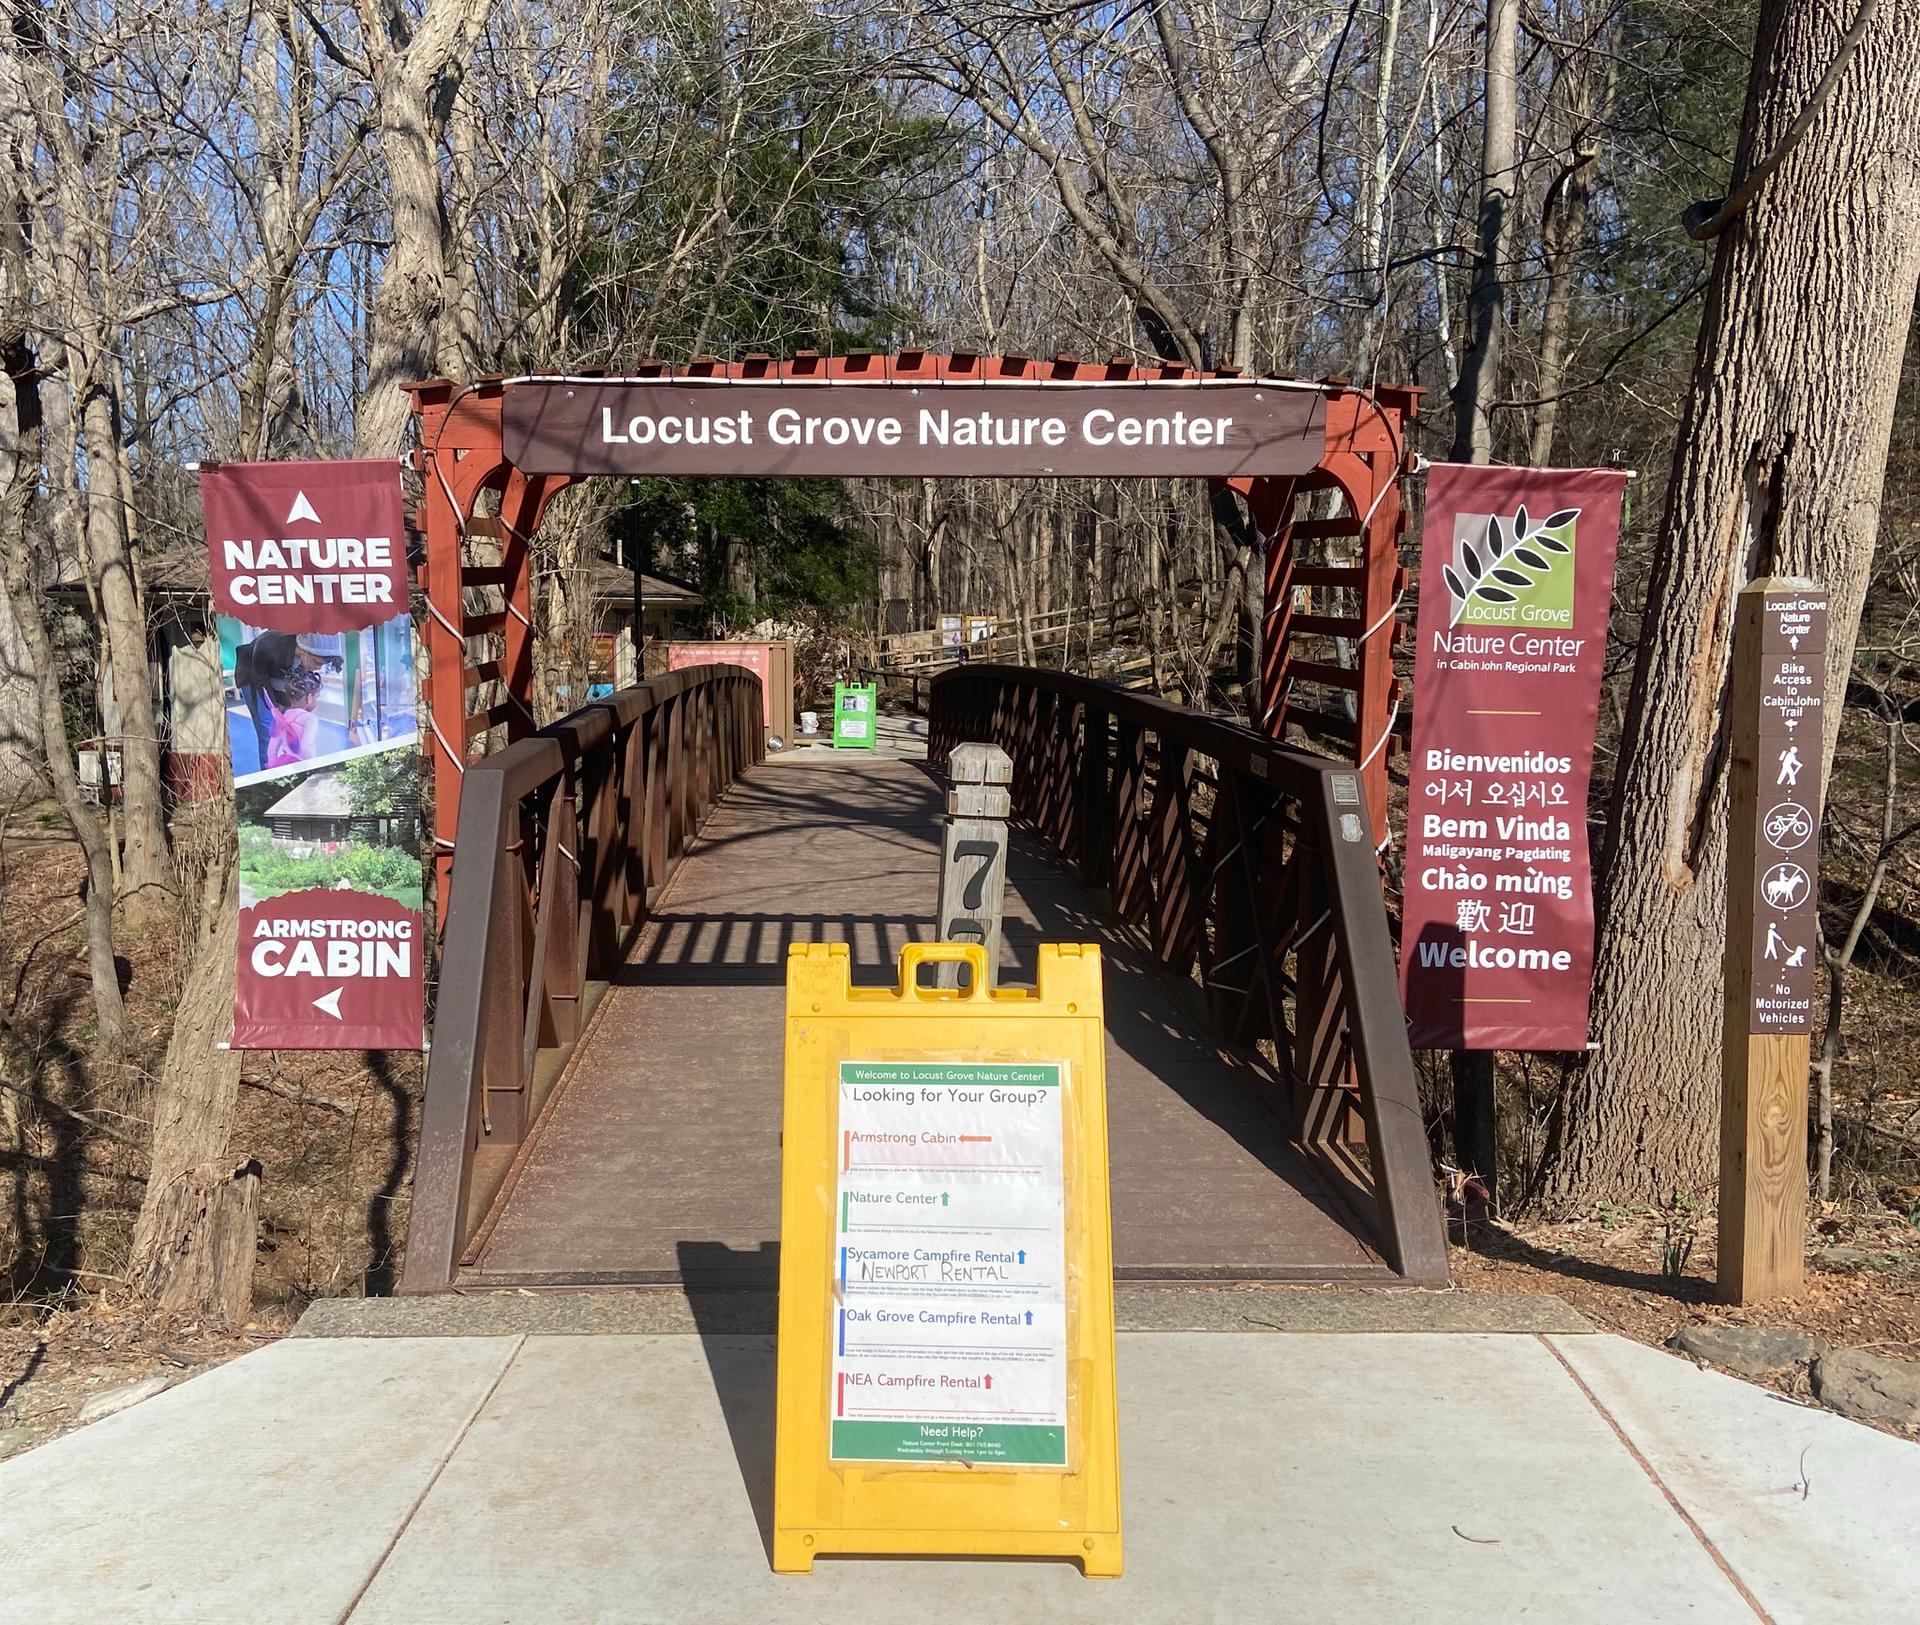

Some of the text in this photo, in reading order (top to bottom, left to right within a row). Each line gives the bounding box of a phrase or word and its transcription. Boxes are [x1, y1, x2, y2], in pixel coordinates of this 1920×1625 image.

[602, 407, 1233, 446] Locust Grove Nature Center
[223, 537, 393, 570] NATURE
[229, 573, 394, 605] CENTER
[1466, 603, 1570, 622] Locust Grove
[1765, 600, 1827, 612] Locust Grove
[1780, 612, 1810, 623] Nature
[1780, 624, 1811, 635] Center
[1433, 630, 1585, 657] Nature Center
[1437, 659, 1576, 674] in Cabin John Regional Park
[1781, 663, 1805, 674] Bike
[1773, 674, 1812, 685] Access
[1787, 686, 1797, 695] to
[1780, 707, 1803, 717] Trail
[1426, 748, 1572, 773] Bienvenidos
[1425, 778, 1569, 808] 어서 오십시오
[1423, 814, 1570, 841] Bem Vinda
[1422, 844, 1571, 862] Maligayang Pagdating
[954, 840, 999, 910] 7
[1421, 864, 1573, 900] Chào mừng
[253, 919, 412, 939] ARMSTRONG
[251, 939, 411, 978] CABIN
[1419, 940, 1572, 971] Welcome
[1775, 984, 1791, 995] No
[1755, 998, 1809, 1009] Motorized
[1759, 1012, 1805, 1024] Vehicles
[855, 1070, 1045, 1081] Welcome to Locust Grove Nature Center!
[853, 1087, 1047, 1107] Looking for Your Group?
[851, 1131, 957, 1146] Armstrong Cabin
[850, 1191, 938, 1205] Nature Center
[847, 1248, 1015, 1264] Sycamore Campfire Rental
[846, 1309, 1021, 1326] Oak Grove Campfire Rental
[845, 1373, 981, 1390] NEA Campfire Rental
[920, 1425, 984, 1440] Need Help?
